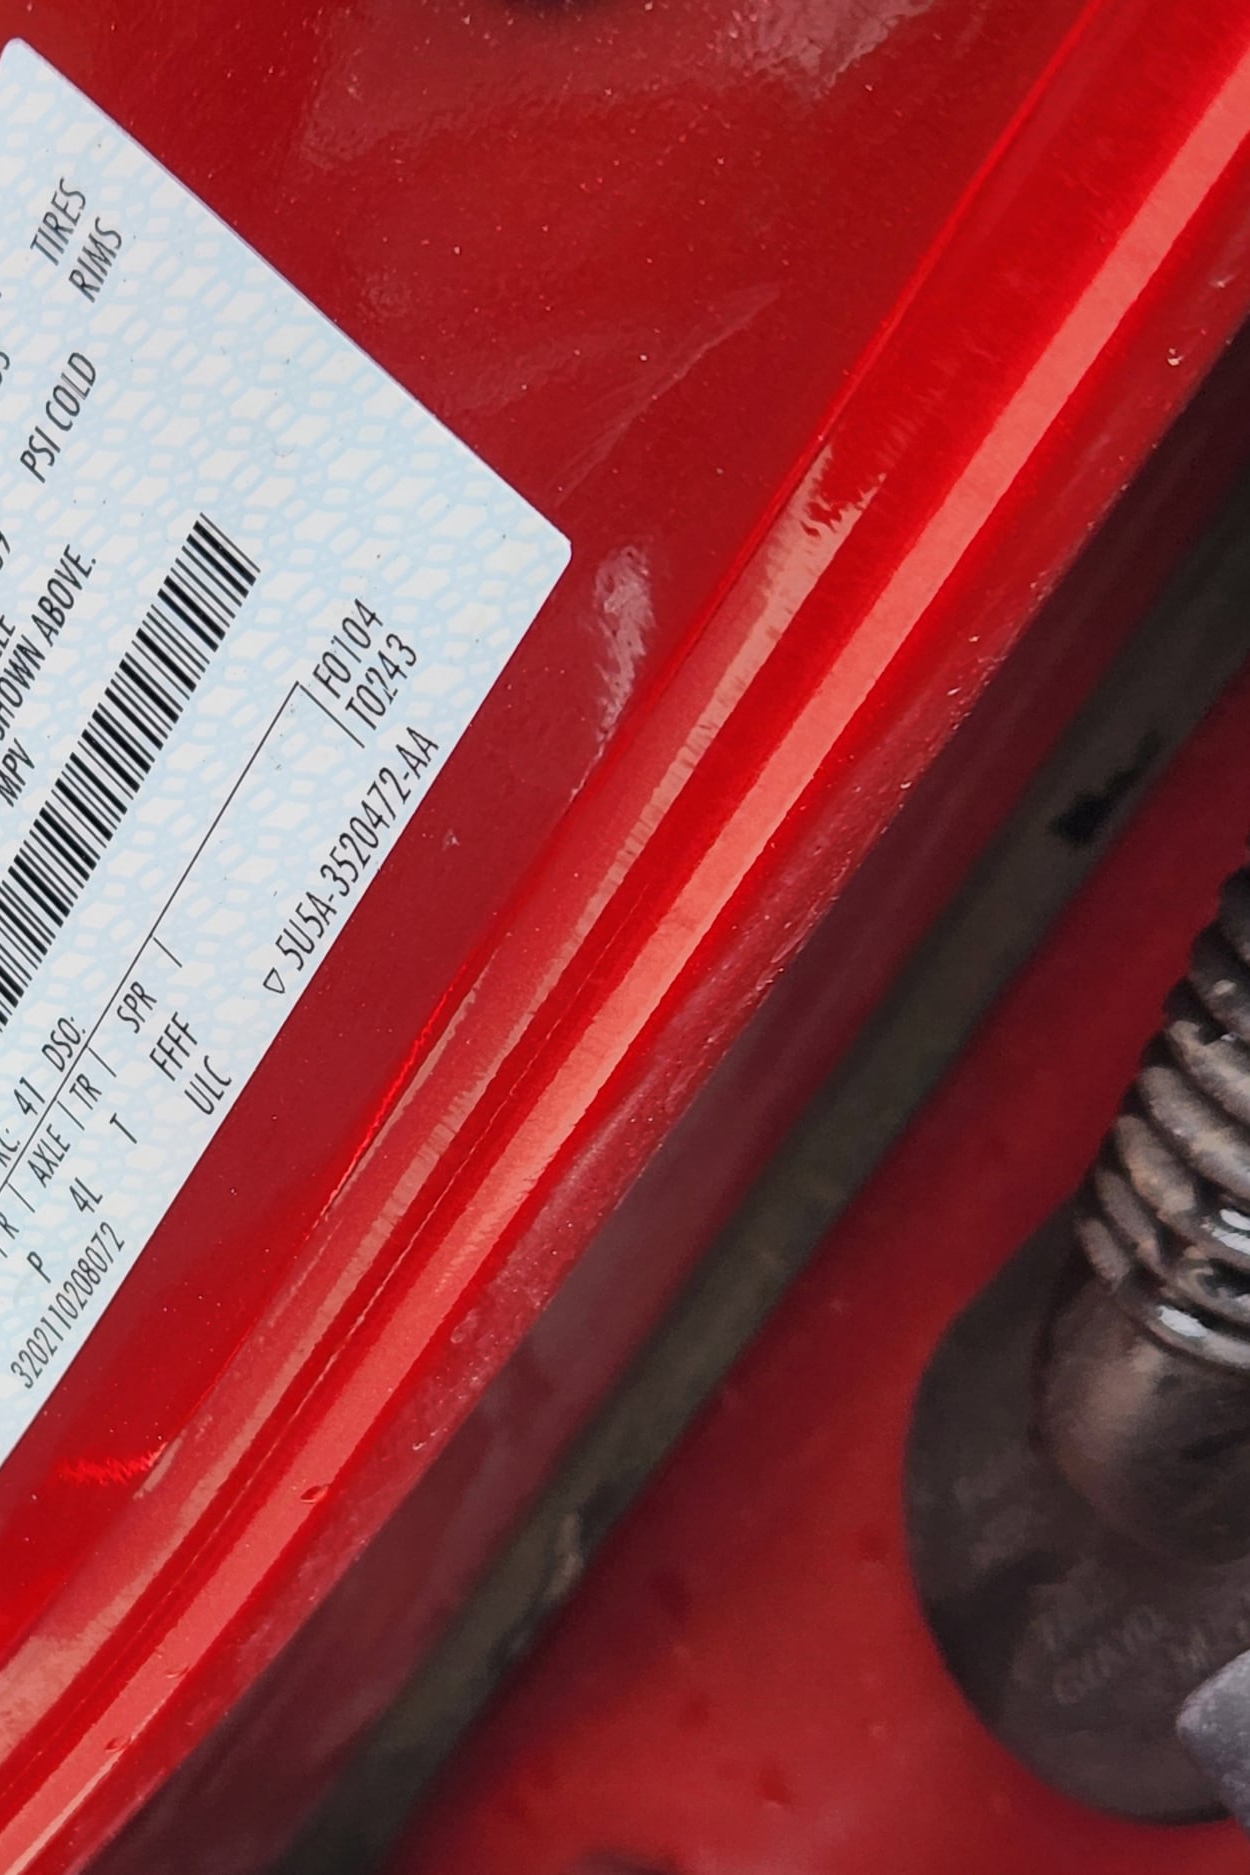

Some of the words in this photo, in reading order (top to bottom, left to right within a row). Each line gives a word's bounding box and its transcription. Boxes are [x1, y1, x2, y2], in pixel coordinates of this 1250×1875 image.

[29, 177, 87, 267] TIRES
[68, 216, 123, 304] RIMS
[19, 425, 62, 484] PSI
[45, 351, 97, 432] COLD
[30, 543, 97, 648] ABOVE.
[311, 597, 384, 700] F0104
[344, 632, 418, 732] T0243
[274, 726, 440, 972] 5U5A-3520472-AA
[116, 980, 158, 1035] SPR
[148, 1010, 199, 1083] FFFF
[13, 1075, 46, 1116] 41
[40, 1015, 87, 1073] DSO:
[68, 1072, 103, 1111] TR
[183, 1054, 233, 1116] ULC
[26, 1122, 71, 1189] AXLE
[108, 1112, 138, 1145] T
[68, 1176, 104, 1214] 4L
[10, 1221, 126, 1390] 3202110208072
[26, 1250, 52, 1284] P
